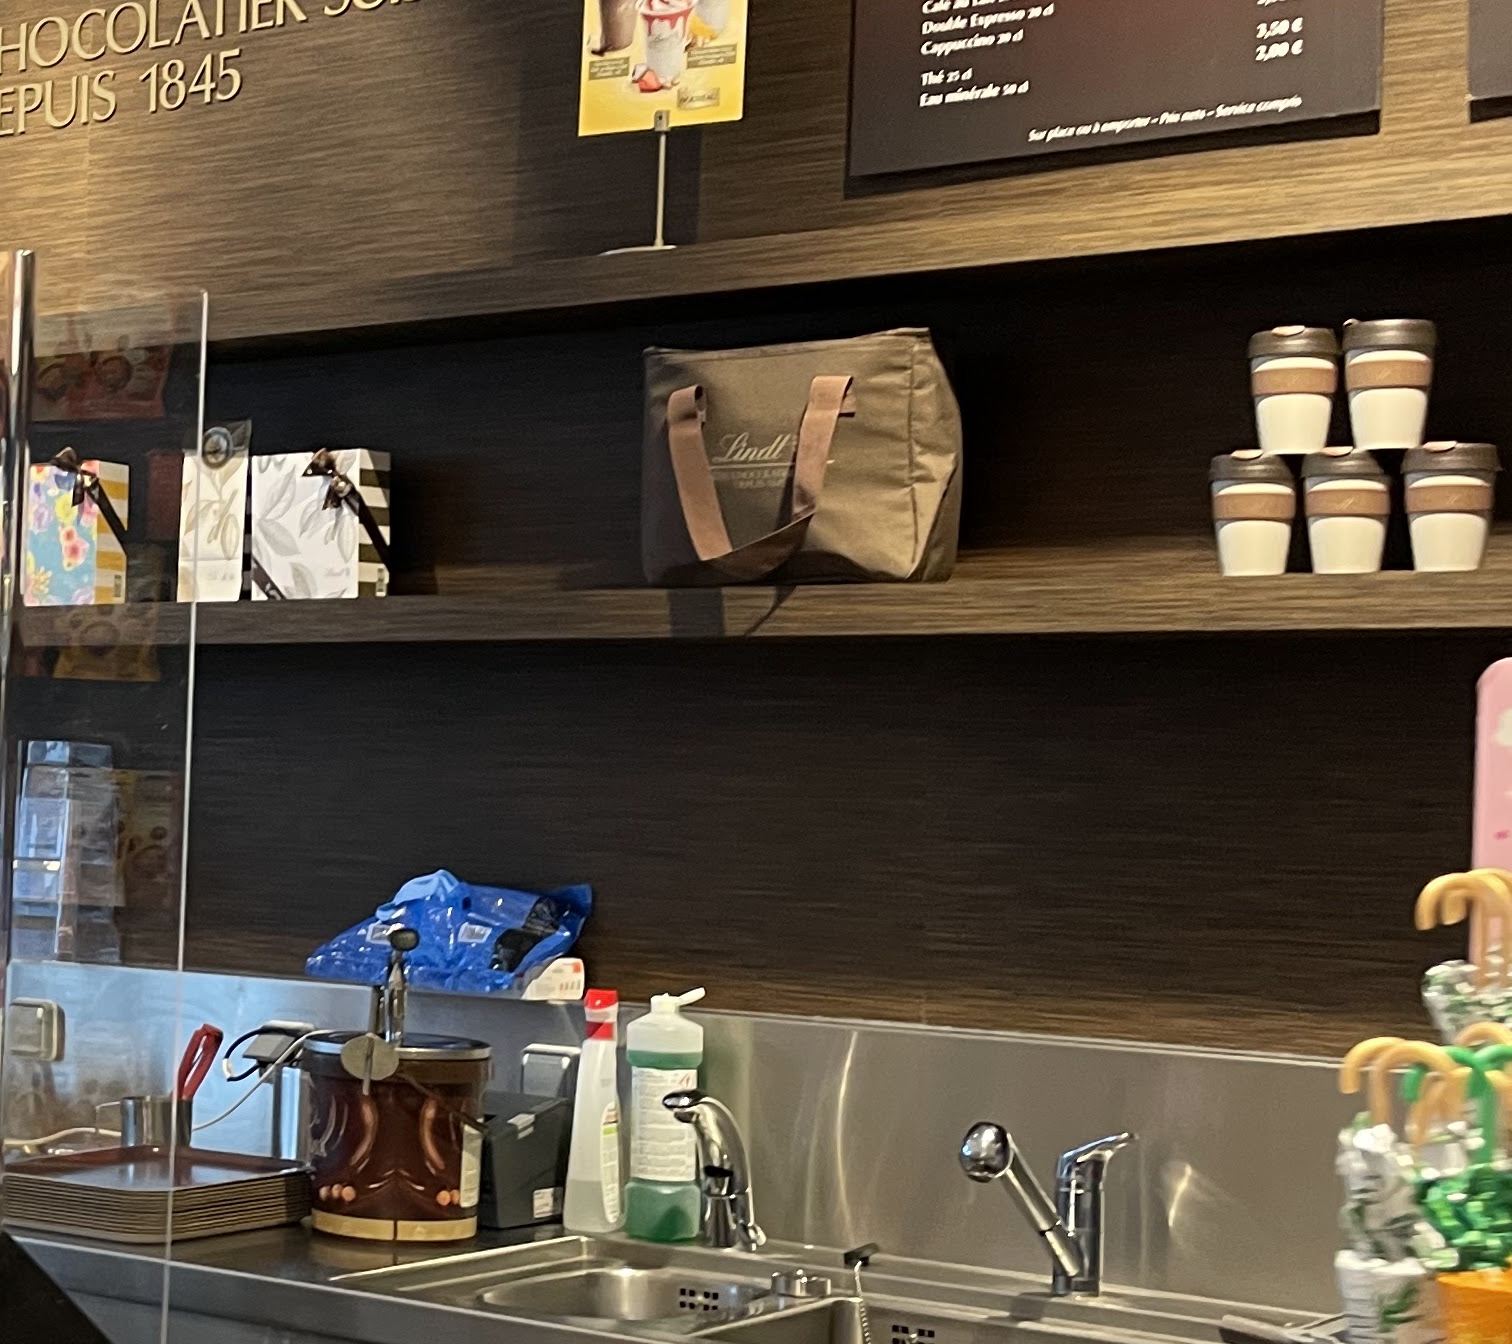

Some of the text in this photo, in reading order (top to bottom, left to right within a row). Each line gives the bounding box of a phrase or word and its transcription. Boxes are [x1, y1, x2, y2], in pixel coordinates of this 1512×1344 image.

[921, 15, 968, 35] Double
[920, 33, 996, 57] Cappuccino
[140, 48, 243, 115] 1845
[920, 69, 945, 86] Thé
[919, 92, 943, 107] Eau
[711, 432, 791, 463] Lindt
